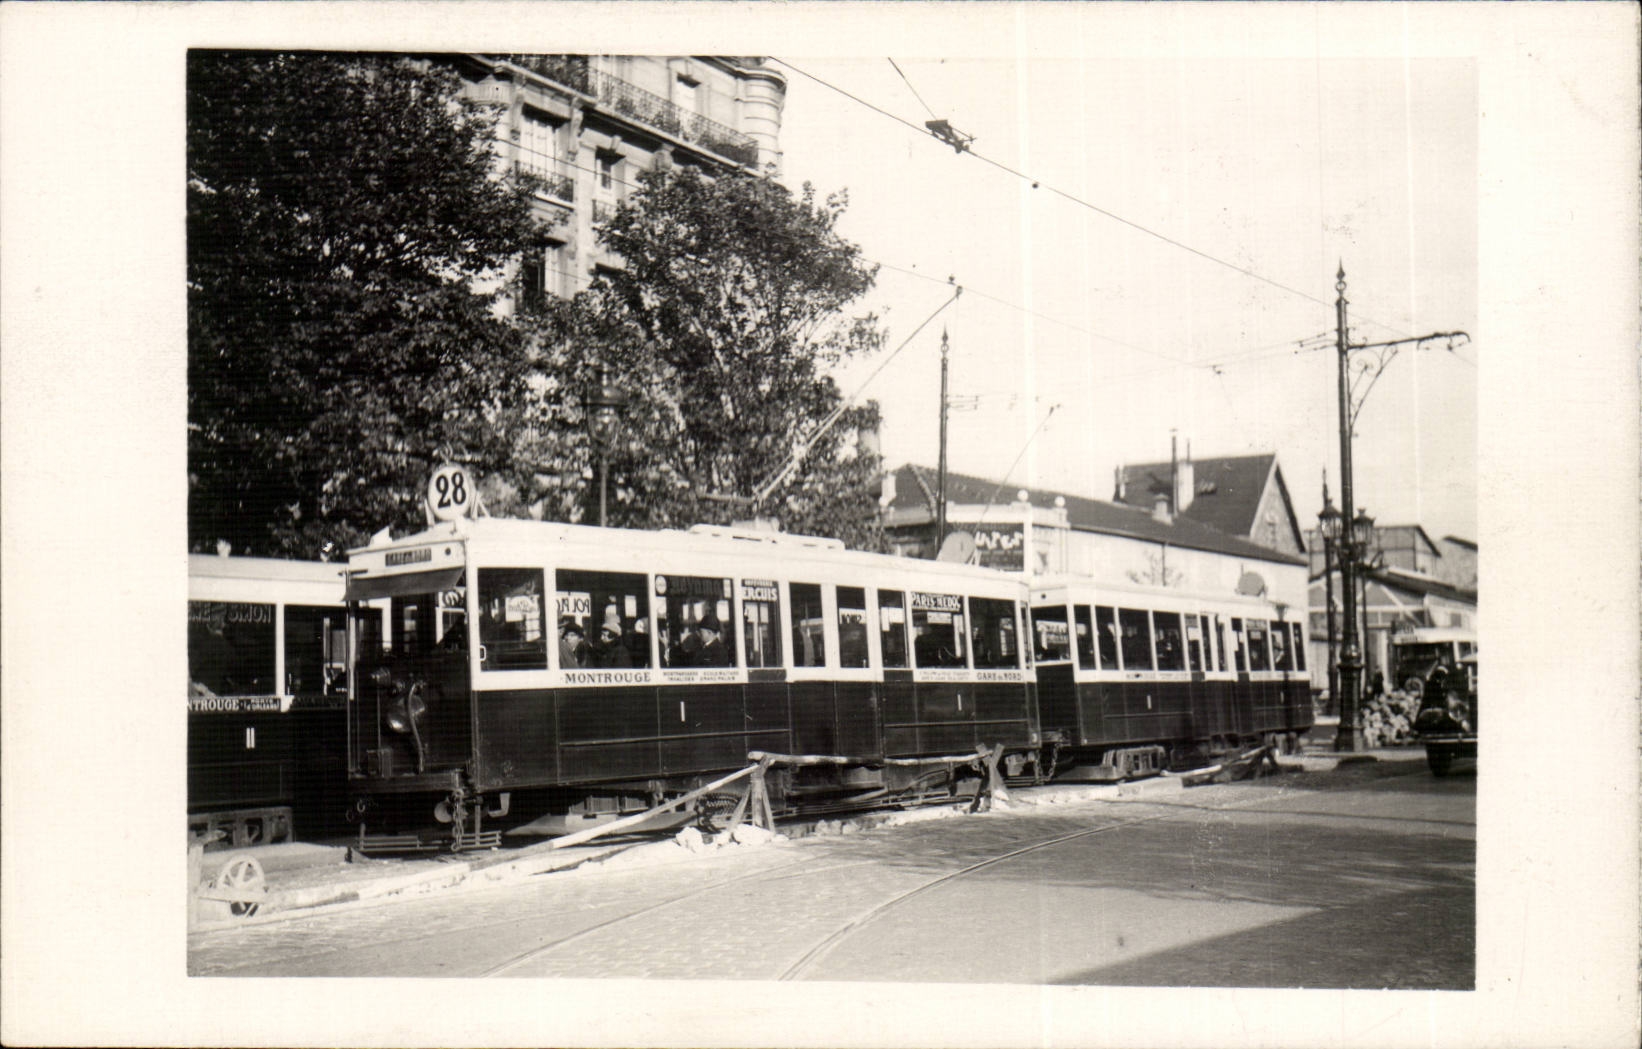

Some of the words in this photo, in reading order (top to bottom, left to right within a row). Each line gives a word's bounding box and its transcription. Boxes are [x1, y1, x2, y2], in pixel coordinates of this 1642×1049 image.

[435, 471, 466, 508] 28
[742, 586, 778, 601] ERCUIS
[565, 671, 651, 684] MONTROUGE
[976, 671, 997, 681] GARE
